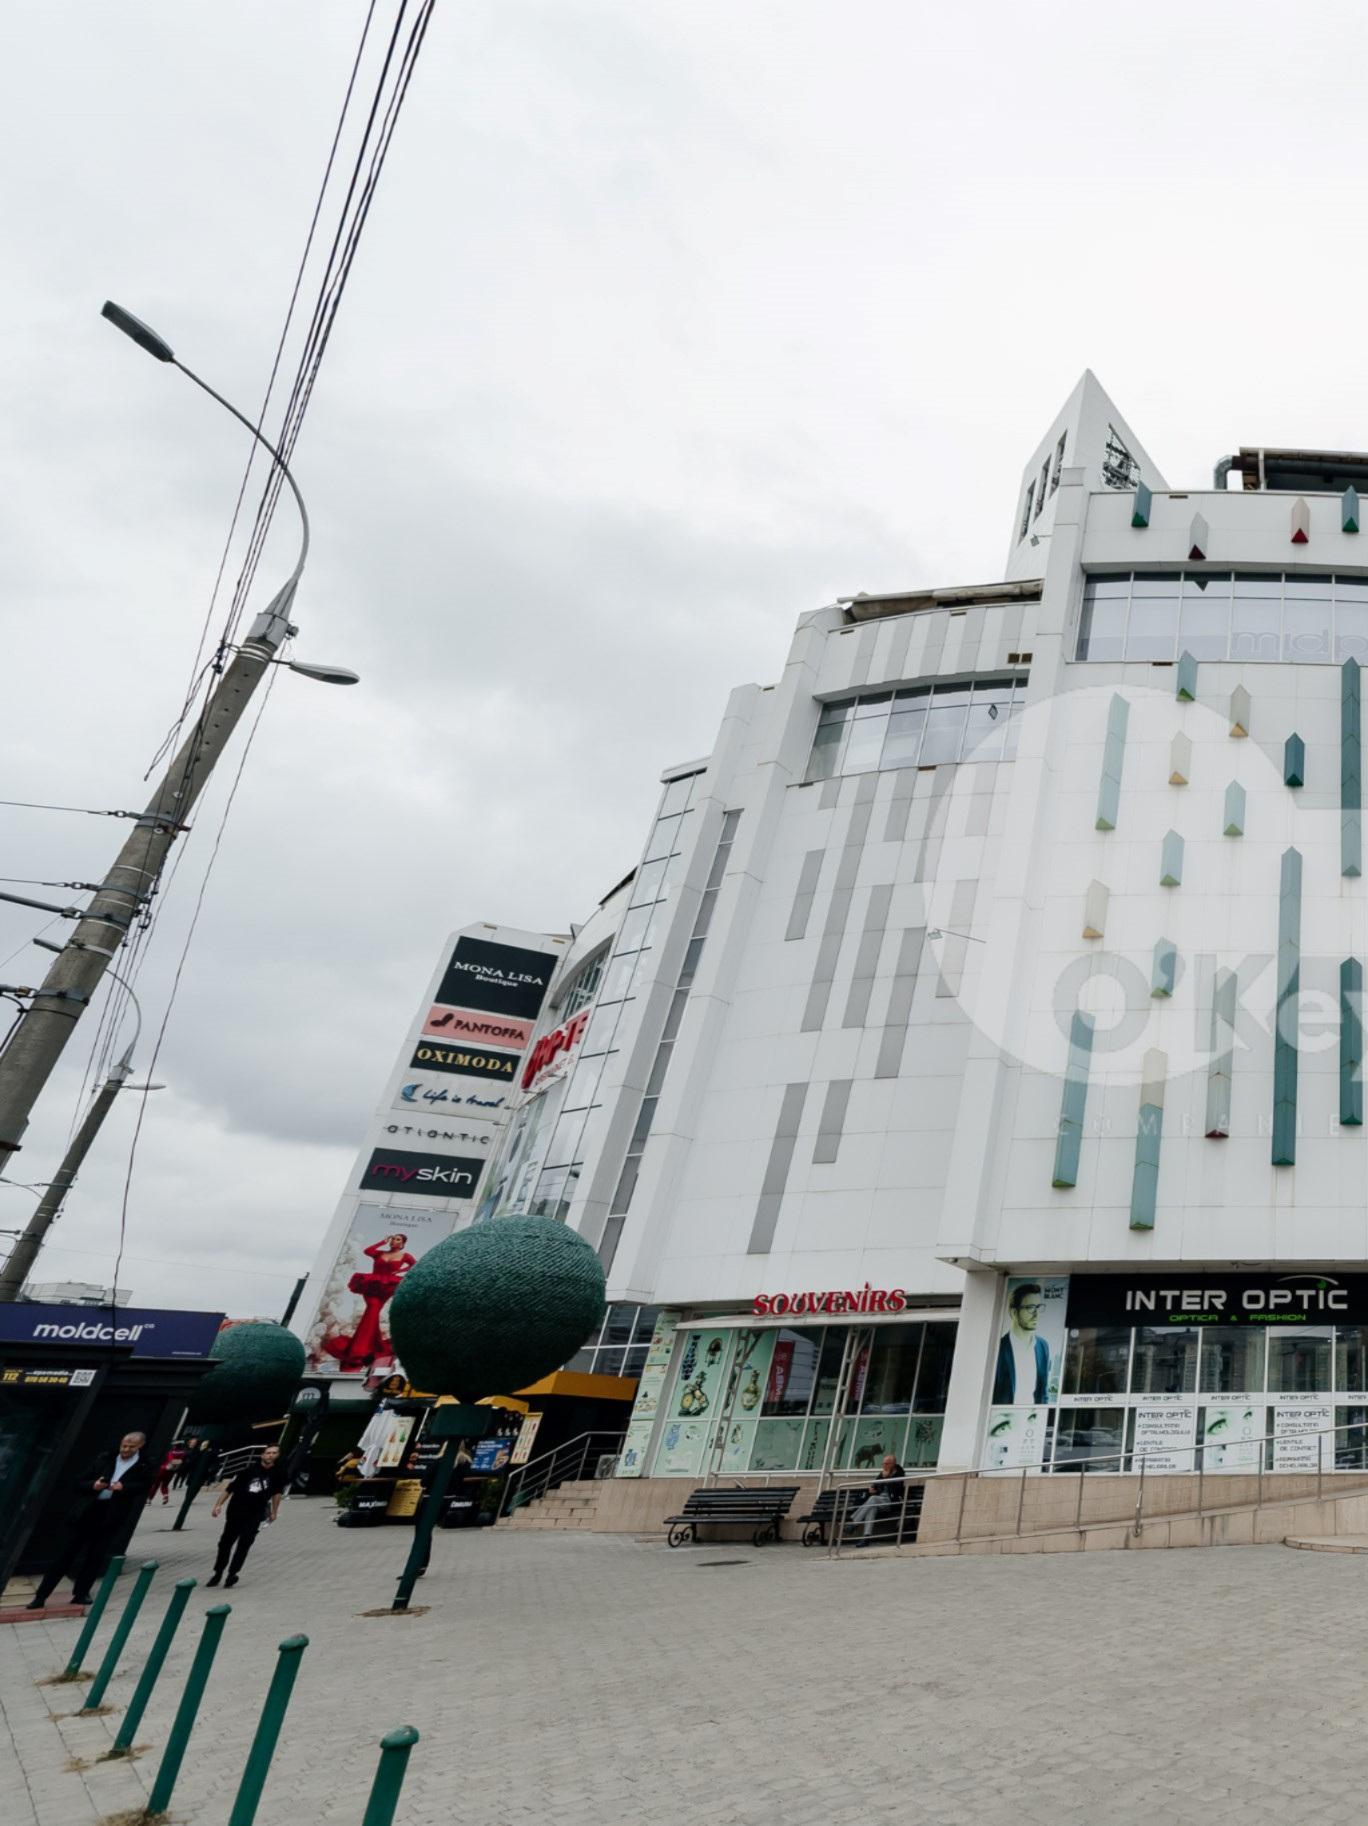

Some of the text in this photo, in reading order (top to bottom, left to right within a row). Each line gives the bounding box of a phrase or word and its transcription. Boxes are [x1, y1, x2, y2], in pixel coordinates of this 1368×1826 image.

[453, 961, 543, 986] MONA LISA
[475, 974, 519, 987] Boutique
[454, 1020, 525, 1041] PANTOFFA
[417, 1048, 513, 1073] OXIMODA
[422, 1088, 505, 1108] Life is travel
[371, 1163, 473, 1184] myskin
[379, 1213, 433, 1223] MONA LISA
[1126, 1285, 1348, 1310] INTER OPTIC
[1169, 1314, 1218, 1322] OPTICA
[33, 1322, 144, 1341] moldcell
[1166, 1409, 1192, 1418] OPTIC
[1304, 1409, 1330, 1417] OPTIC
